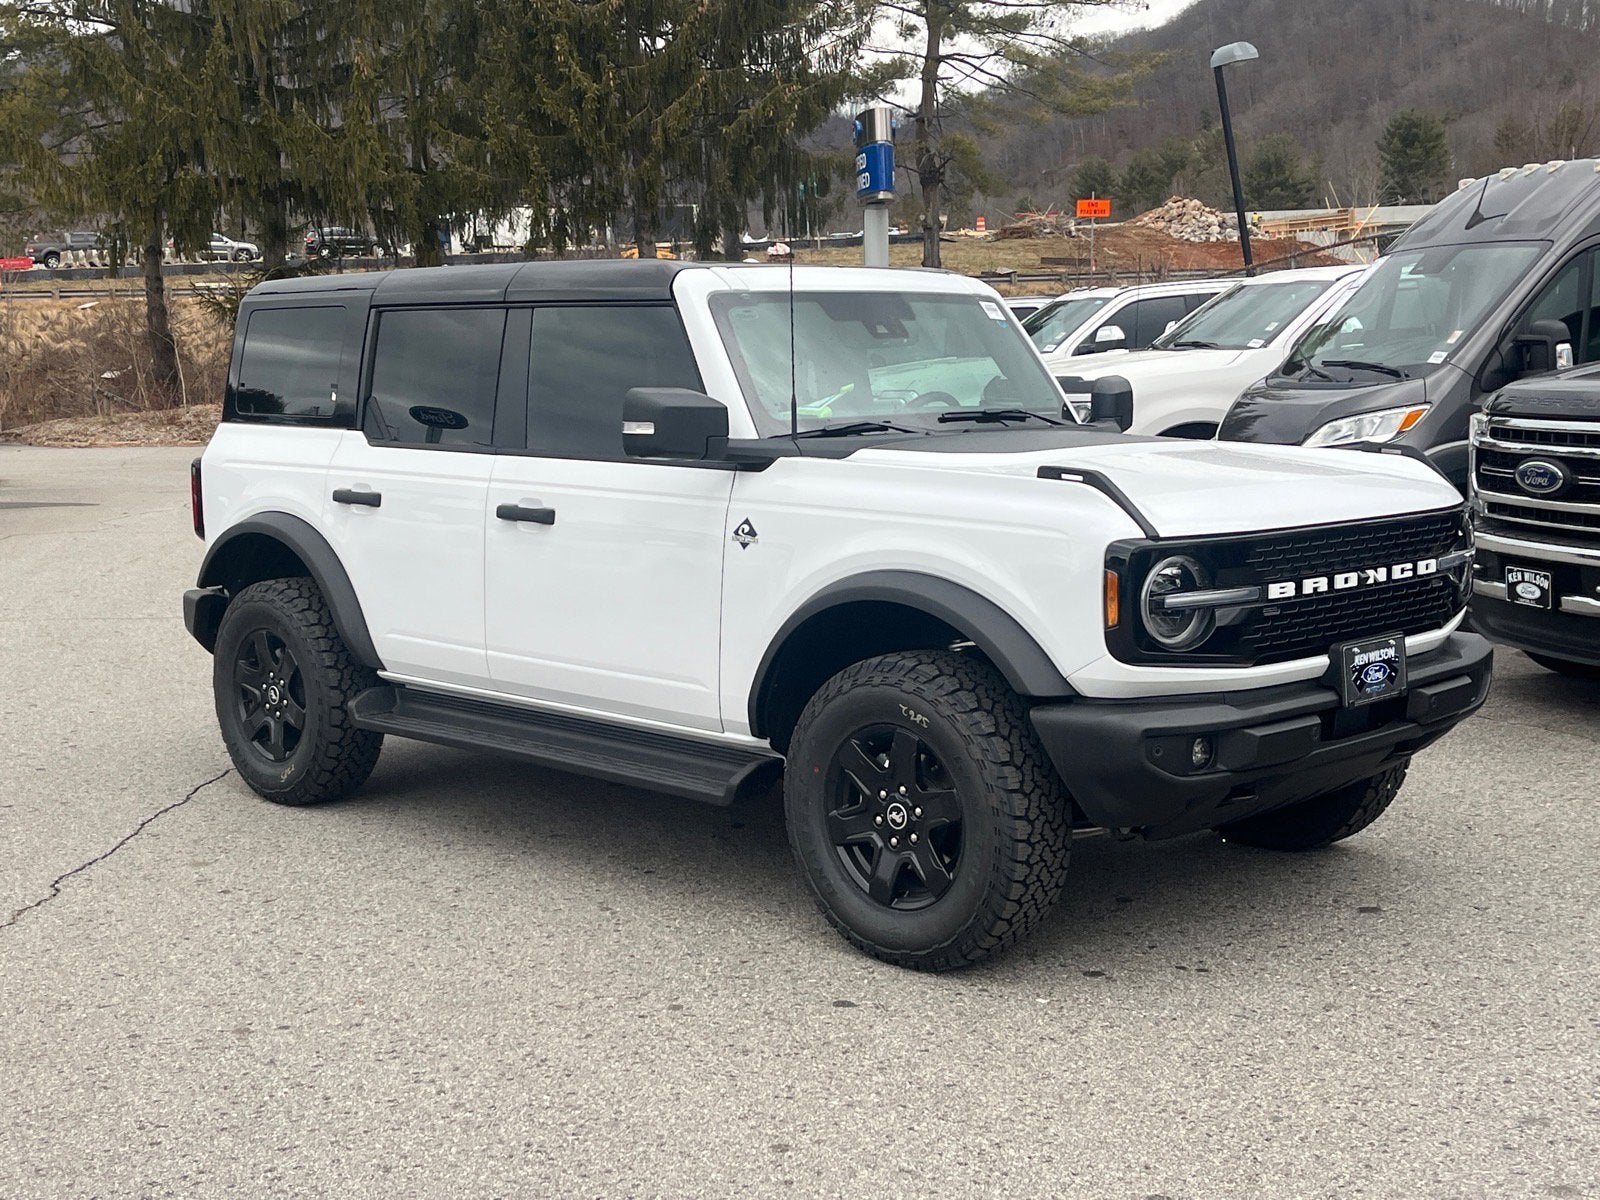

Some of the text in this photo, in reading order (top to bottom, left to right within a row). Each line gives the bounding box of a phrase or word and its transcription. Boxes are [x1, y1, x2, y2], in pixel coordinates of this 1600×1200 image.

[1524, 467, 1549, 487] Ford
[1267, 558, 1437, 600] BRONCO
[1508, 571, 1522, 583] KEN
